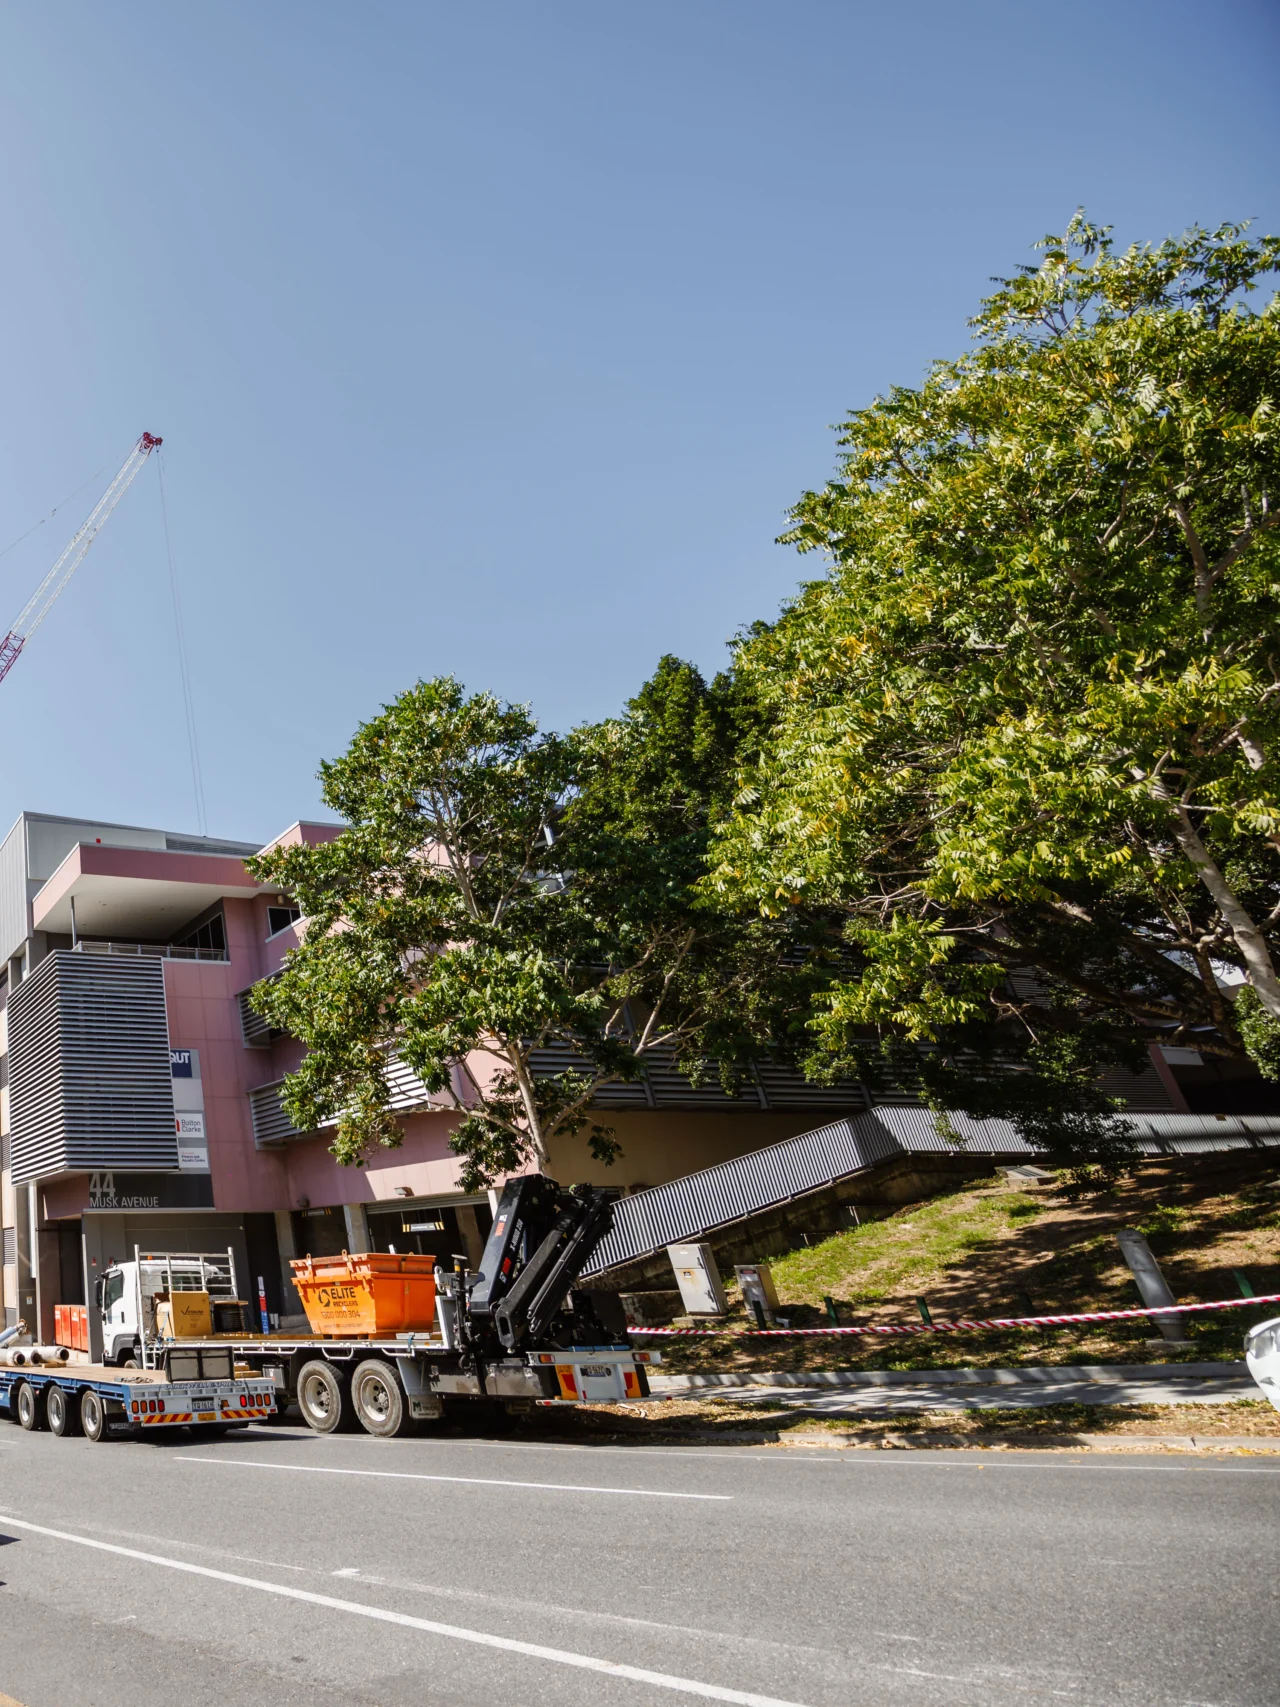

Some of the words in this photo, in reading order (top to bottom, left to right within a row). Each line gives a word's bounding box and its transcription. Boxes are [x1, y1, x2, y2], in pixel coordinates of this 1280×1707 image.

[181, 1119, 201, 1127] Bolton
[181, 1125, 202, 1133] Clarke
[89, 1173, 116, 1198] 44
[90, 1197, 119, 1208] MUSK
[121, 1196, 159, 1207] AVENUE
[331, 1286, 357, 1299] ELITE
[347, 1309, 361, 1318] 304
